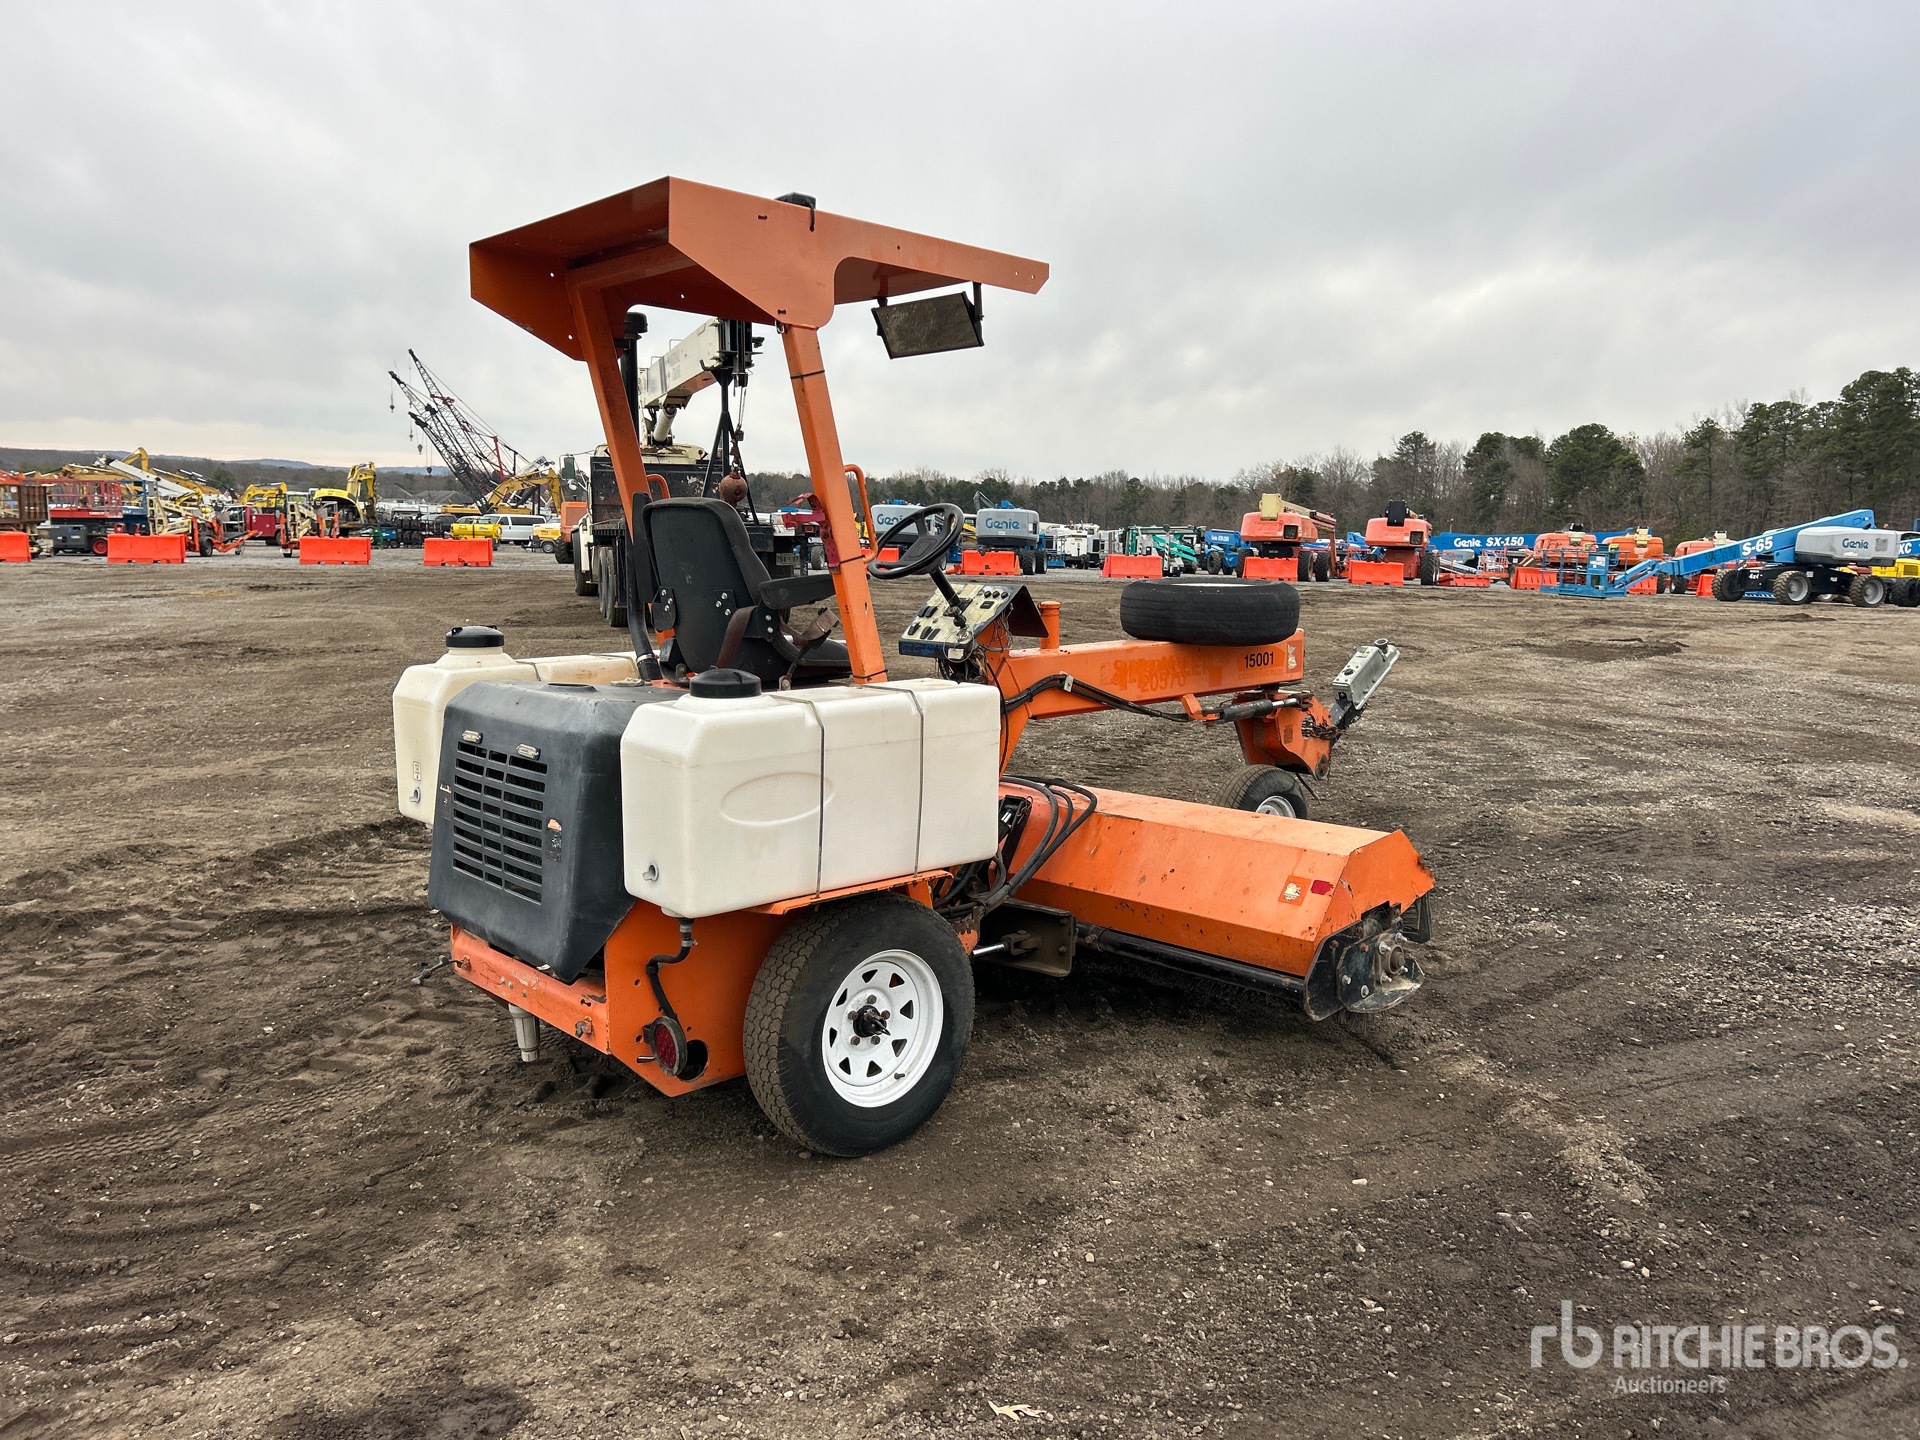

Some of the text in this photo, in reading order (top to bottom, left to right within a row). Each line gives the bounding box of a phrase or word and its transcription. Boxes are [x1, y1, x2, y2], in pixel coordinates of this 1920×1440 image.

[877, 513, 904, 525] Gen
[985, 517, 1020, 529] Genie
[1453, 536, 1525, 548] Genie SX-150
[1741, 536, 1774, 556] S-65
[1842, 537, 1869, 549] Genie
[1243, 651, 1275, 669] 15001
